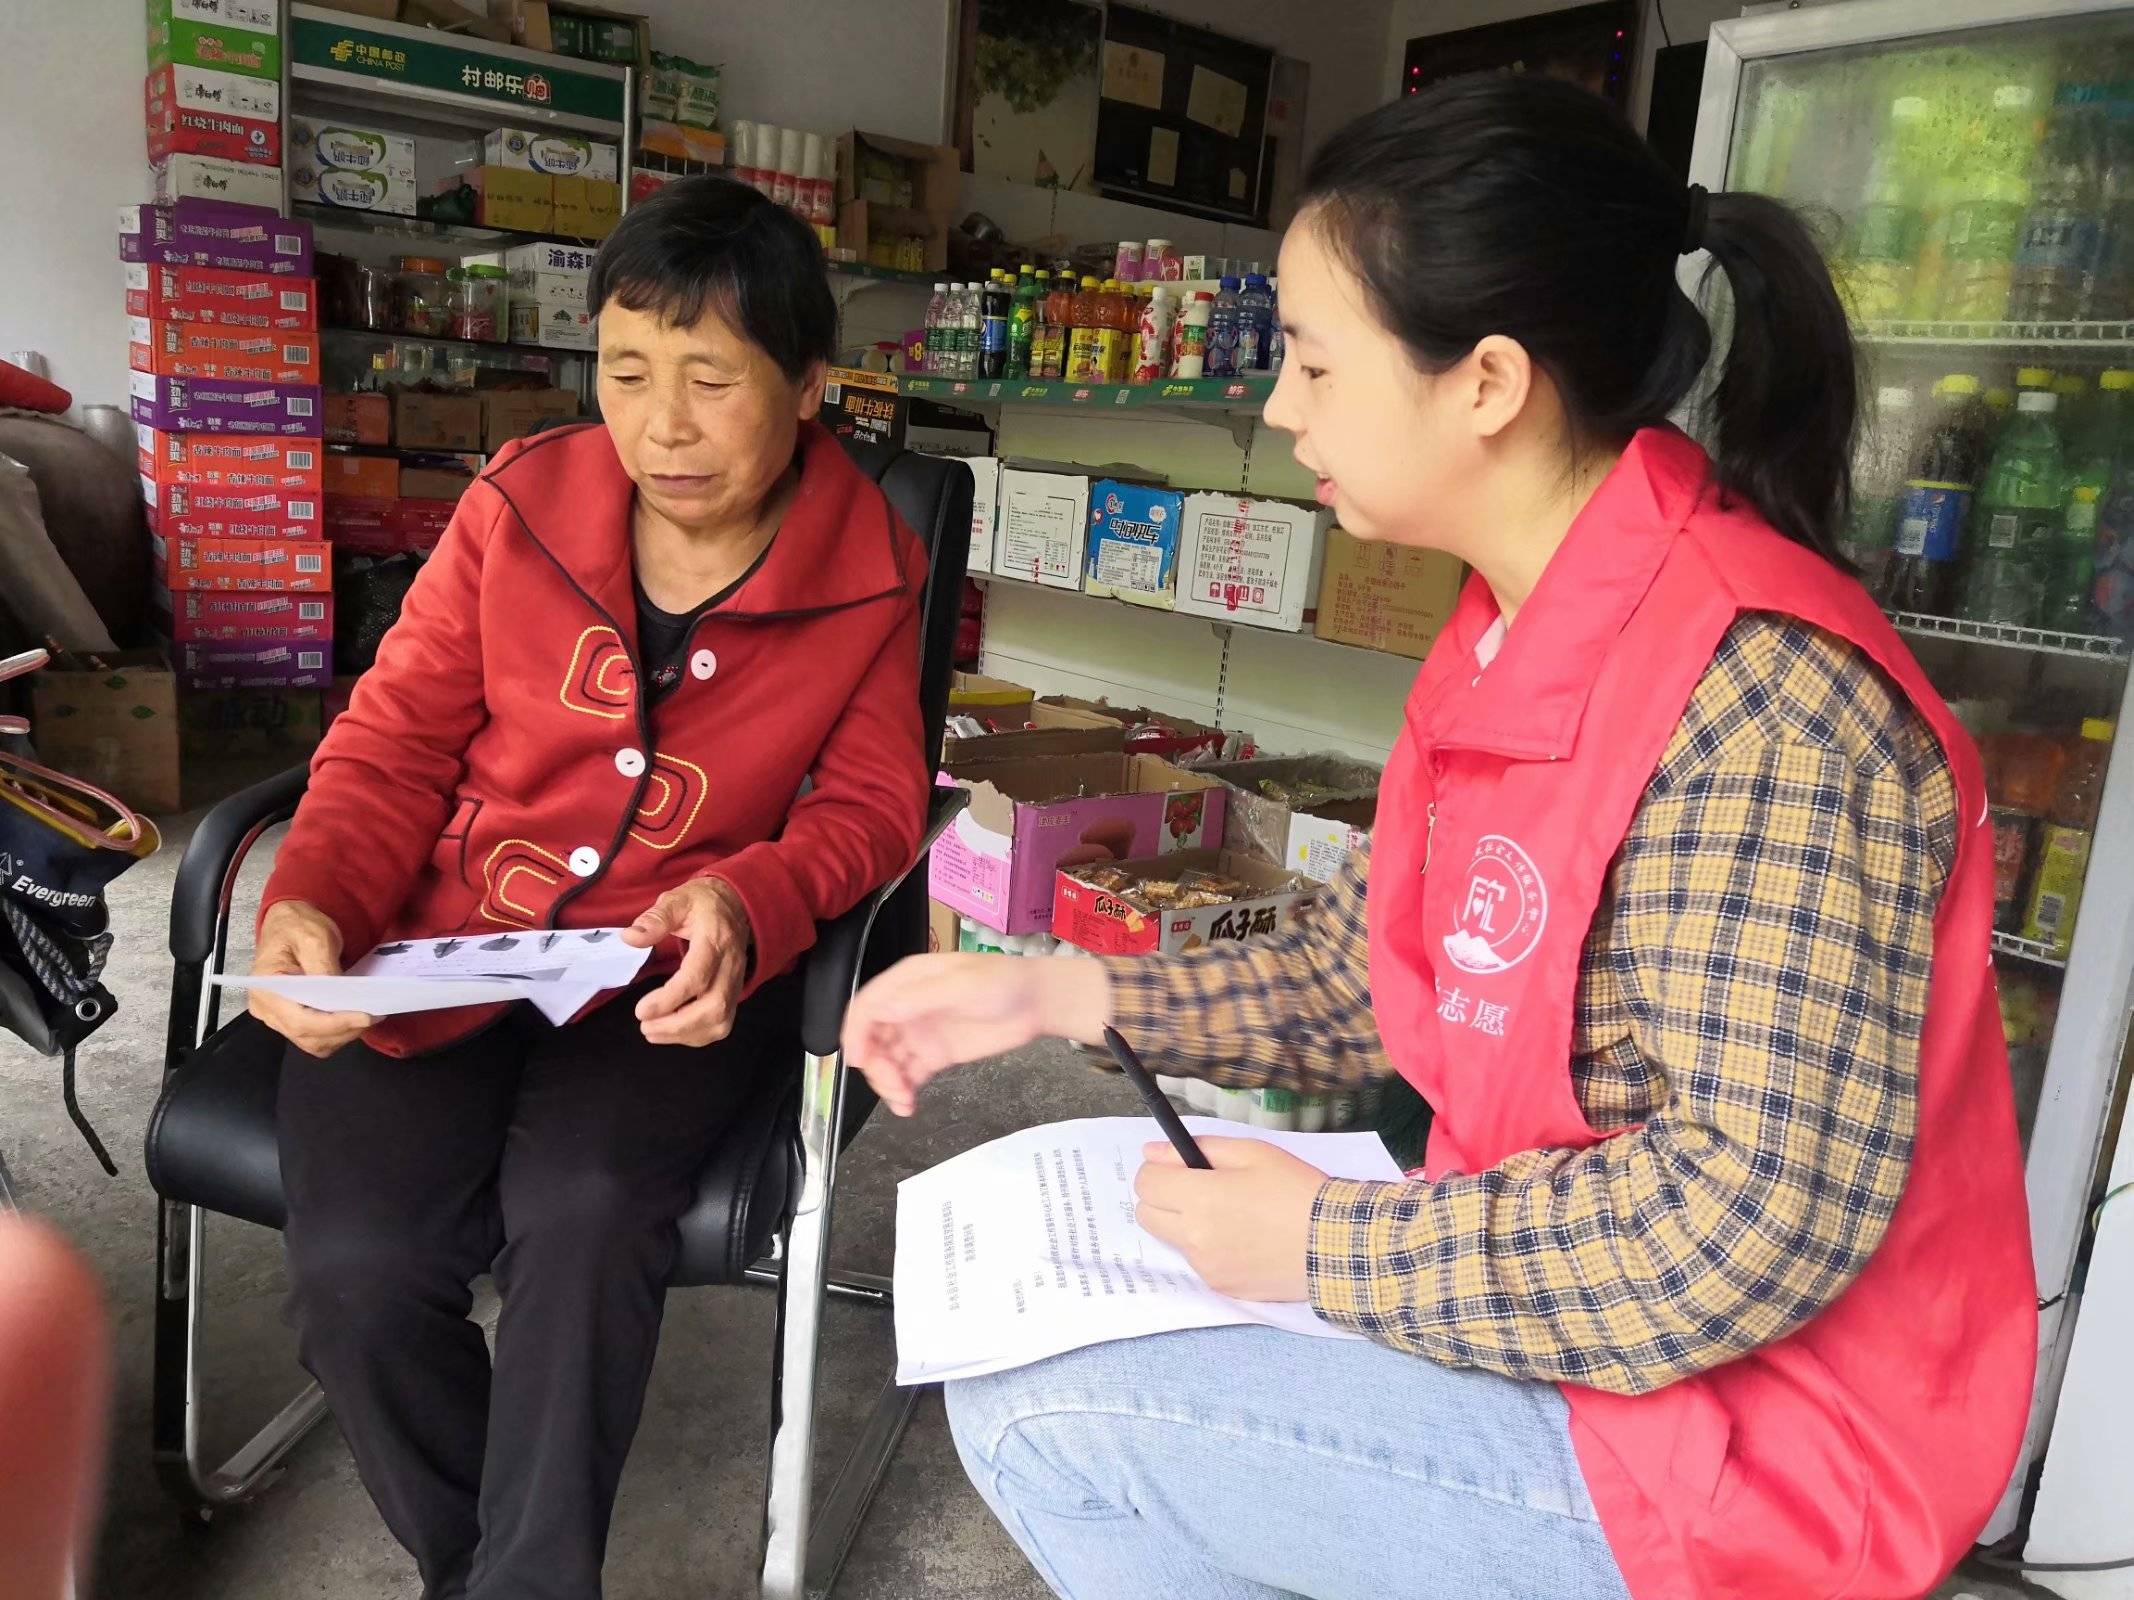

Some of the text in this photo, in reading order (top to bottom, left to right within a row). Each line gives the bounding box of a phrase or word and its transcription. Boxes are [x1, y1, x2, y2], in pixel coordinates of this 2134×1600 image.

[356, 43, 407, 63] 中国邮政
[356, 57, 406, 72] CHINA POST
[461, 64, 550, 103] 村邮乐购
[12, 875, 96, 907] Evergreen
[1093, 895, 1127, 921] 瓜子酥
[1208, 904, 1278, 942] 瓜子酥
[1434, 980, 1512, 1038] 志愿
